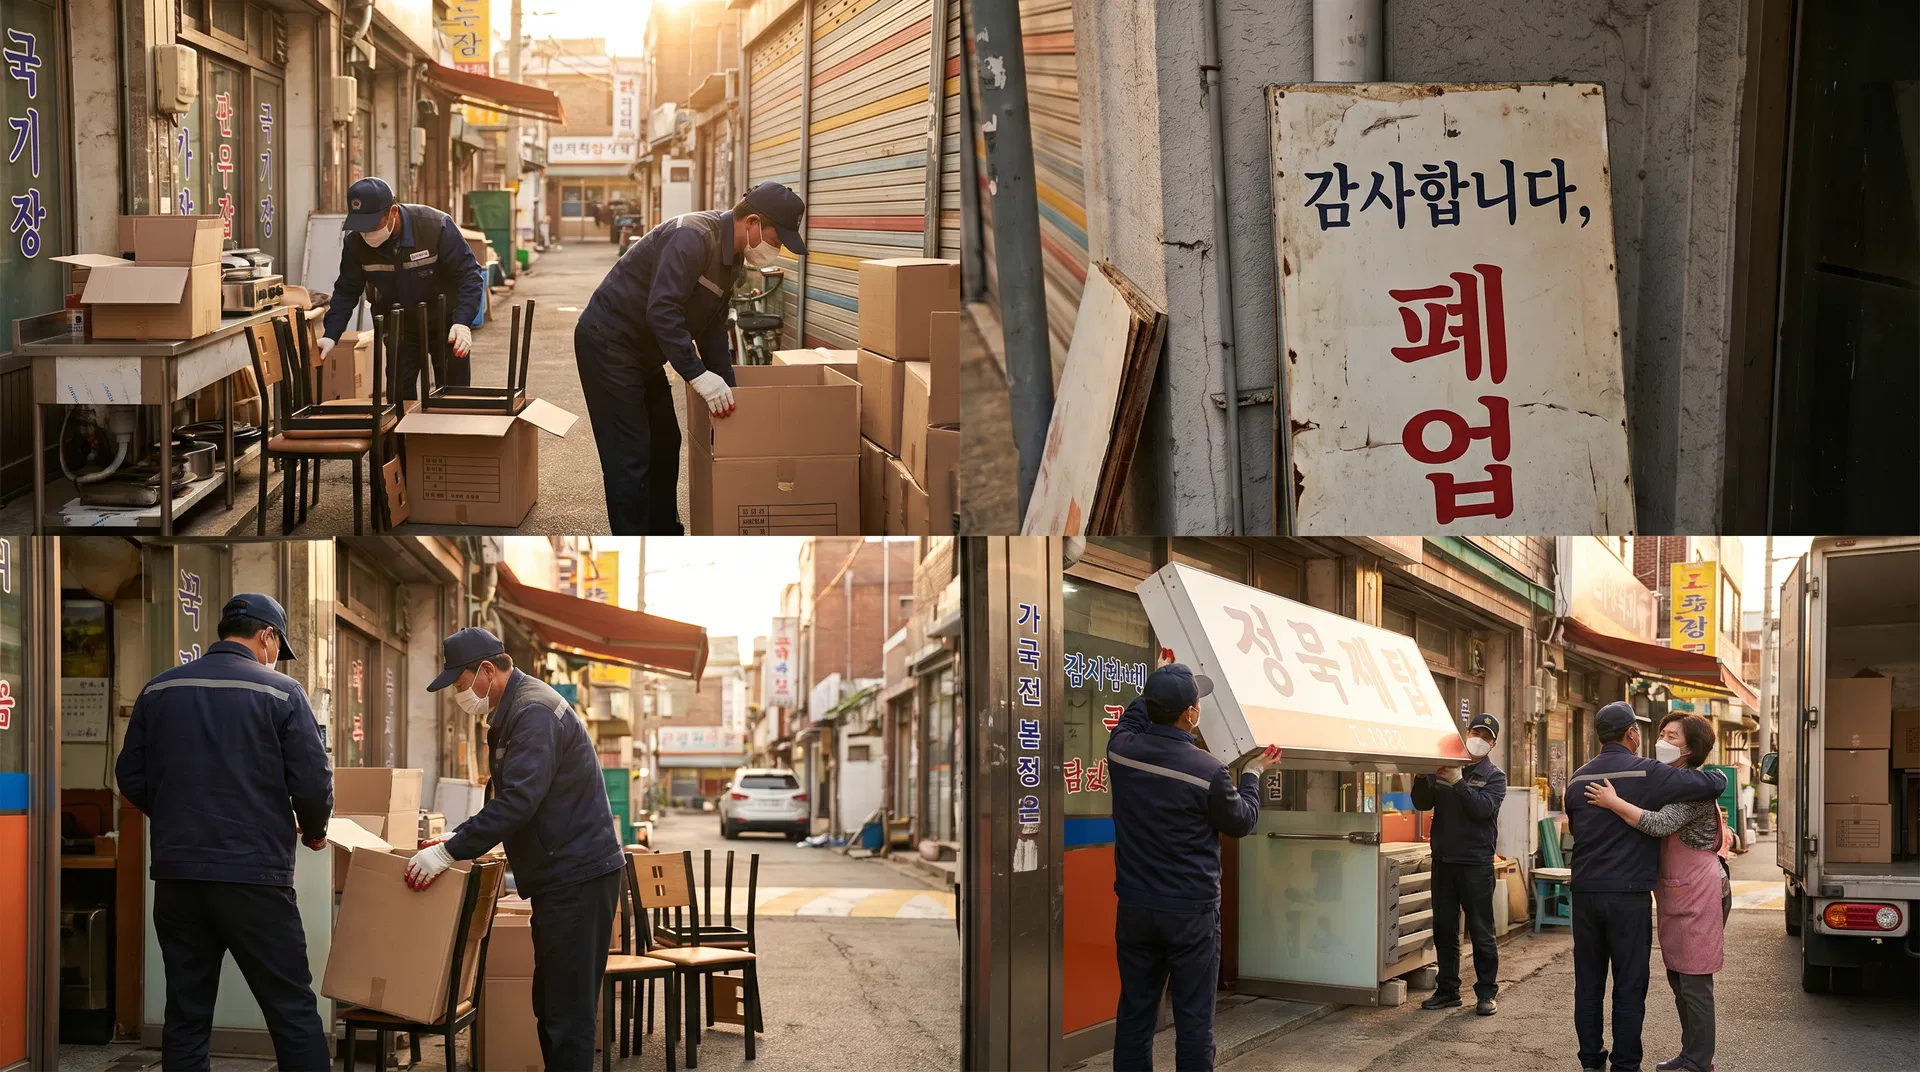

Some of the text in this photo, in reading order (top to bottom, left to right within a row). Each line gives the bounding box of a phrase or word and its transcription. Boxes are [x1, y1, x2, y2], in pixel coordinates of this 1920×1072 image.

[3, 28, 47, 259] 국기장
[1304, 158, 1591, 231] 감사합니다,
[1388, 263, 1514, 526] 폐업
